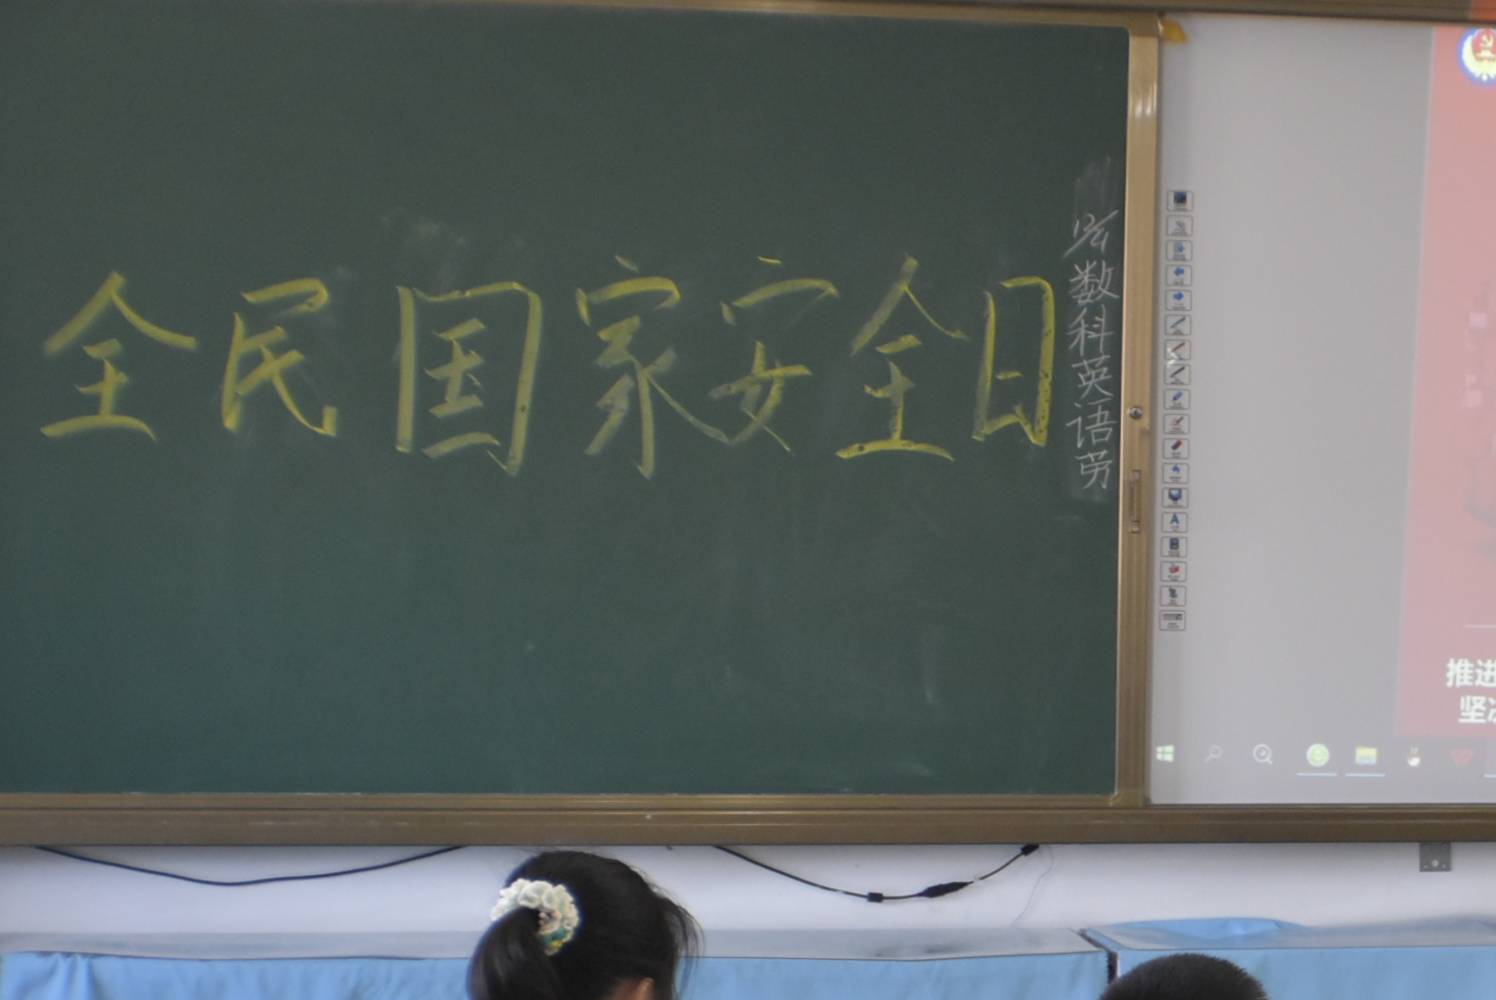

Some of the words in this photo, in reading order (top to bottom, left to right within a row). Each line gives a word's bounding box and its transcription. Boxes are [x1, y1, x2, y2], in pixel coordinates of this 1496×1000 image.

[41, 253, 1056, 478] 全民国家安全日
